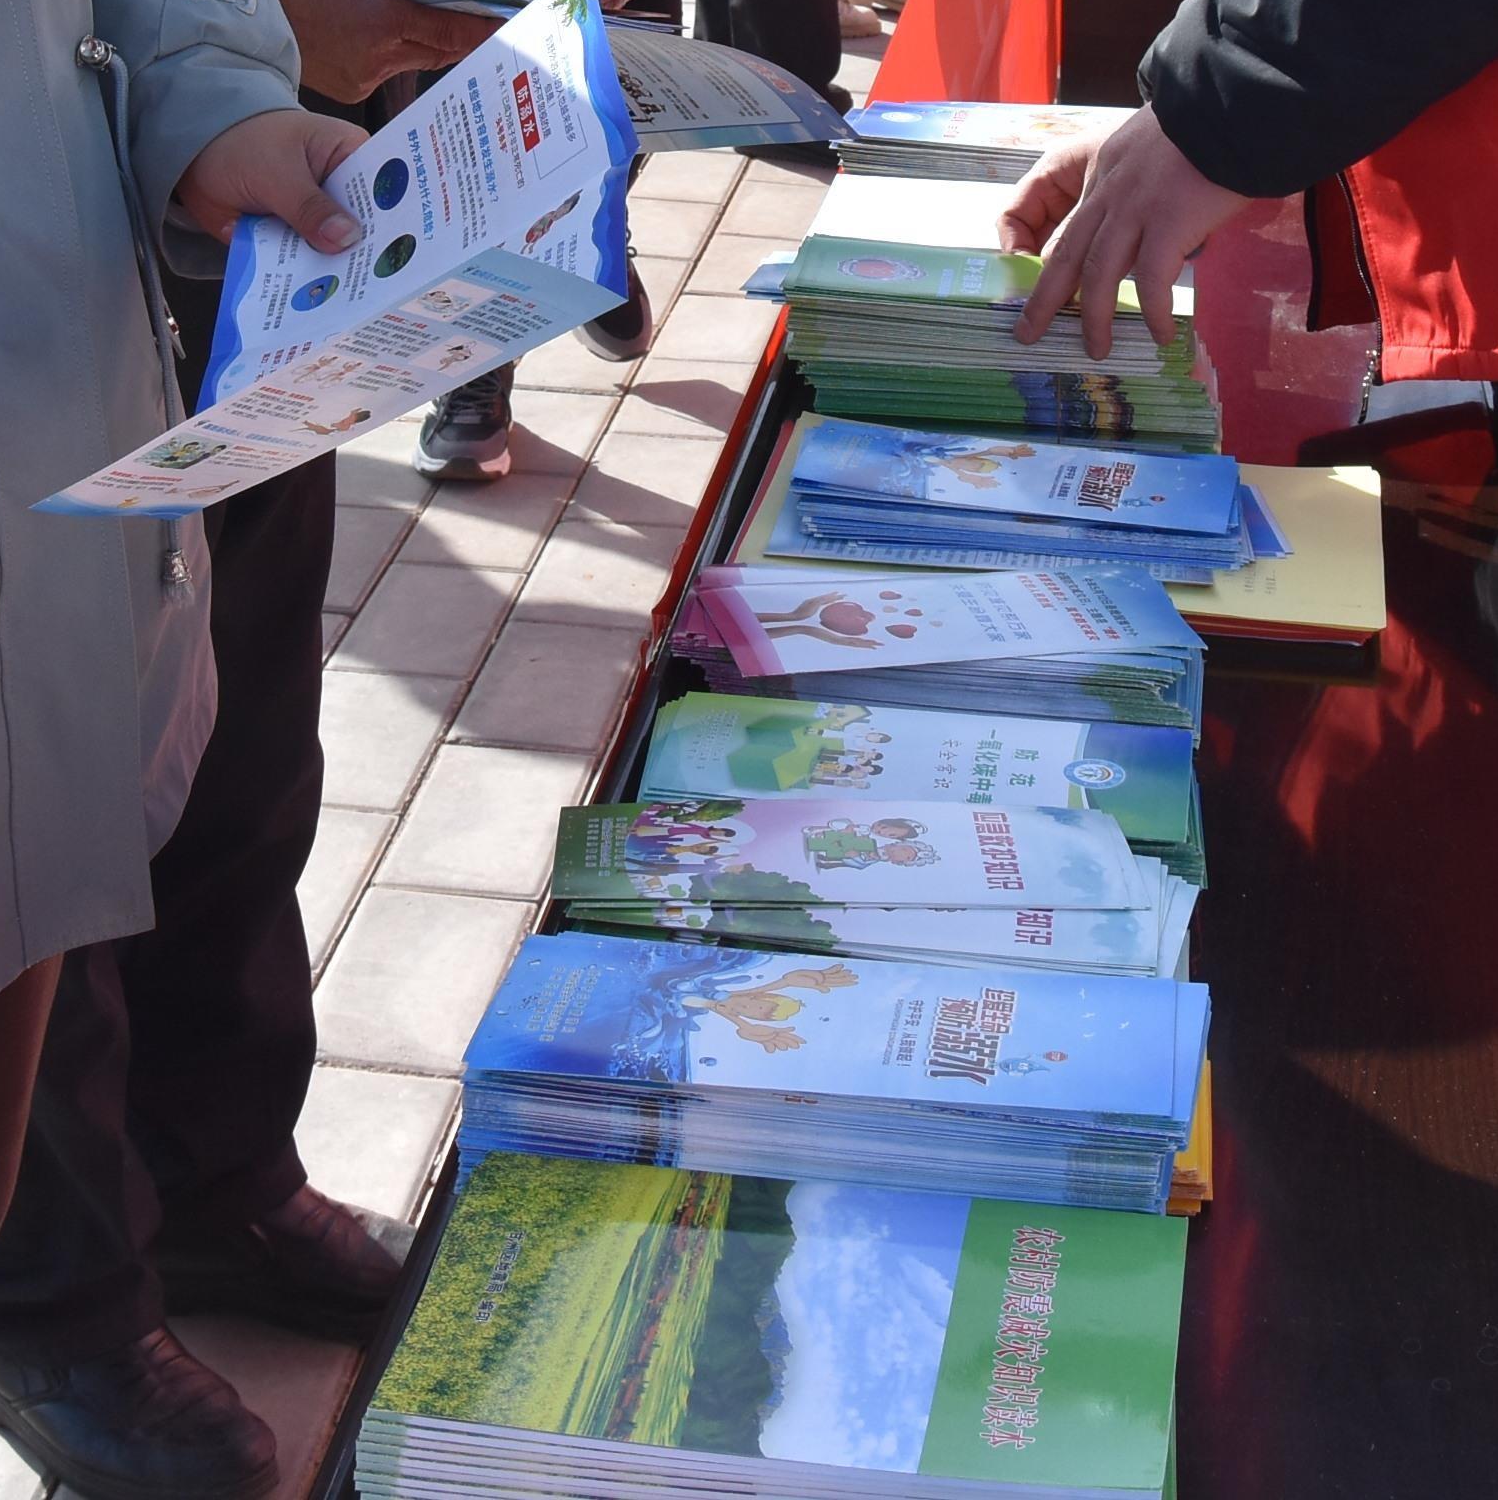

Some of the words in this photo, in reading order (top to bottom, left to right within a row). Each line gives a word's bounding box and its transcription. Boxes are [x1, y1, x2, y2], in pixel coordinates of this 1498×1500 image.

[467, 74, 498, 205] 哪些地方容易发生溺水？
[516, 84, 536, 139] 防溺水
[407, 126, 432, 244] 野外水域为什么危险？
[933, 738, 962, 789] 安全常识
[967, 728, 1004, 805] 一氧化碳中毒
[1009, 748, 1040, 788] 防范
[972, 810, 1026, 893] 应急救护知识
[928, 996, 999, 1086] 预防溺水
[980, 987, 1016, 1035] 珍爱生命
[979, 1225, 1065, 1450] 农村防震减灾知识读本
